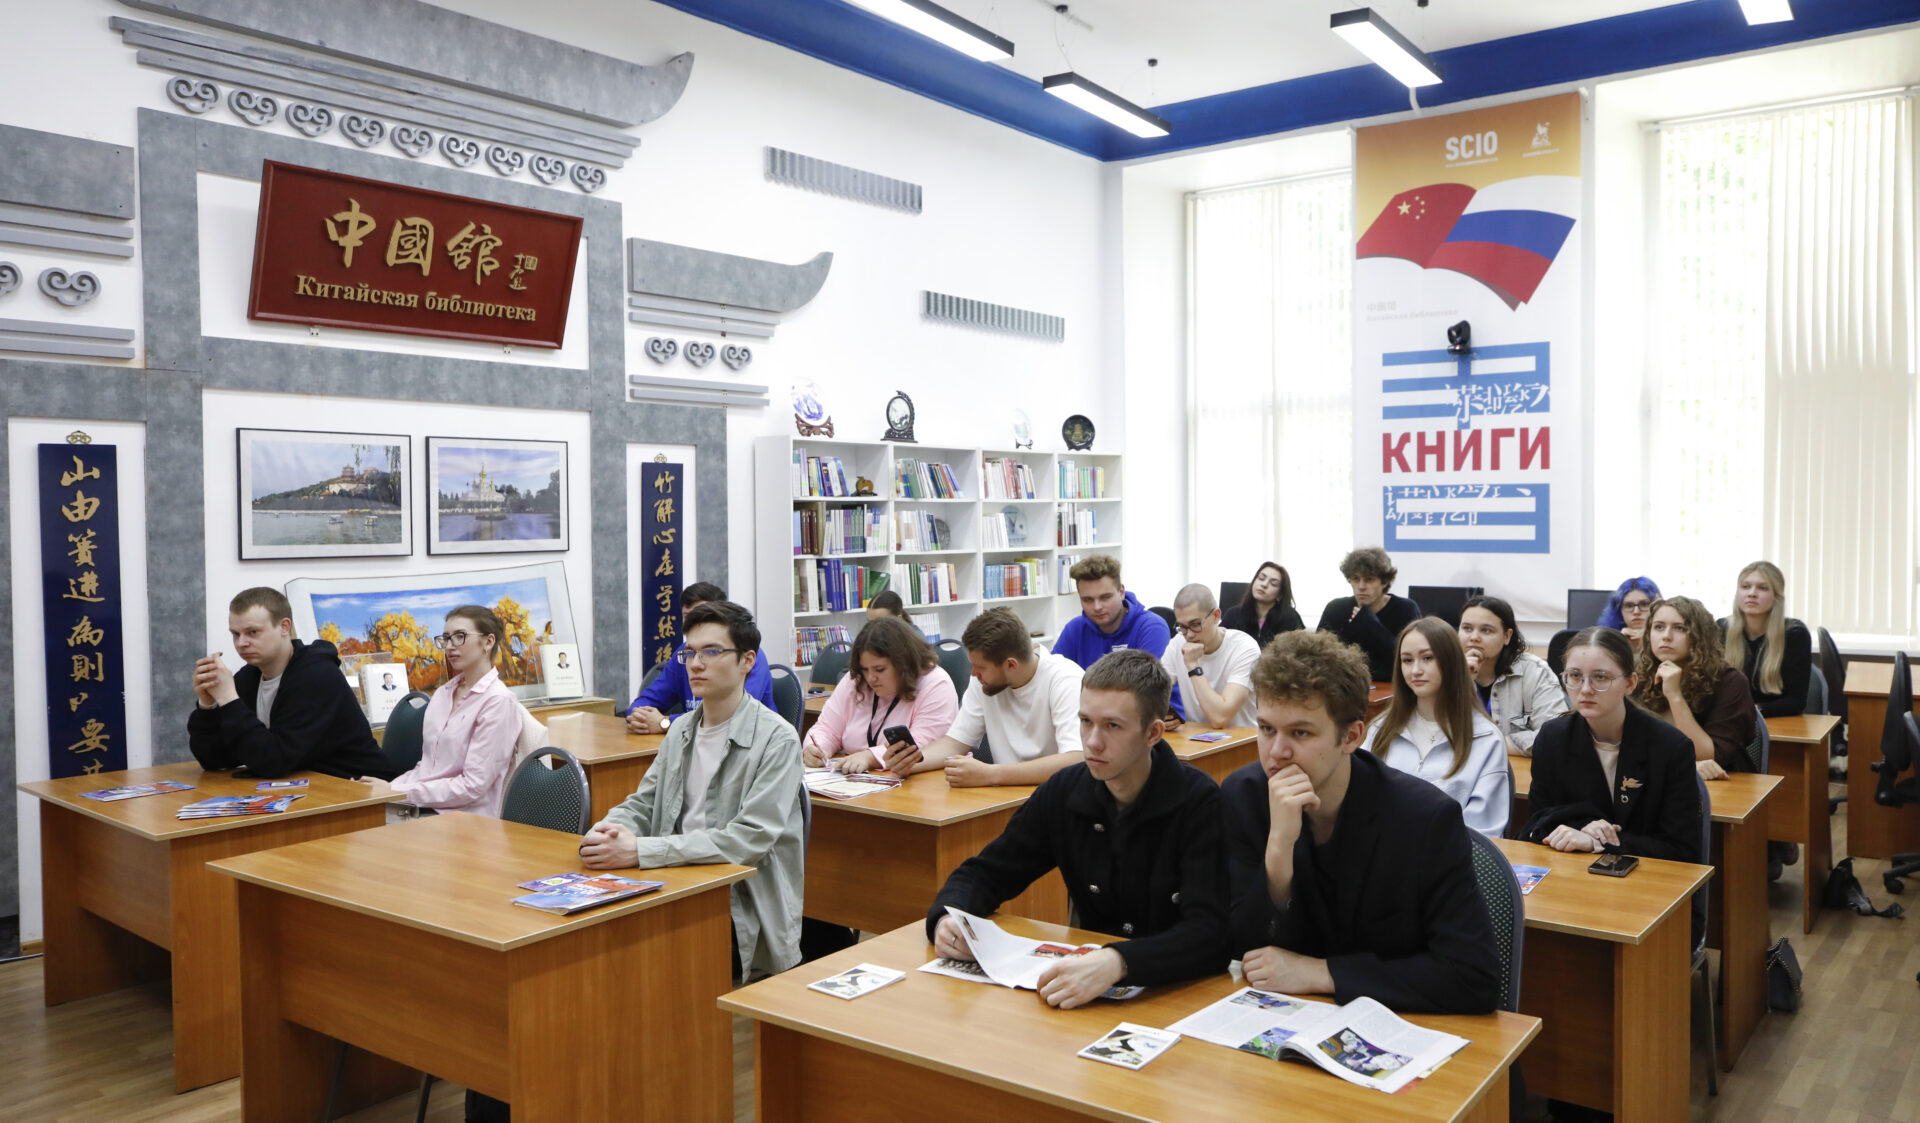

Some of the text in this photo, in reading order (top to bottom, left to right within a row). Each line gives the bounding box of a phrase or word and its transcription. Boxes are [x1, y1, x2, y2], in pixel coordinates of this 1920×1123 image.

[1445, 131, 1498, 161] SCIO
[295, 275, 536, 322] Китайская библиотека
[1382, 426, 1551, 474] КНИГИ
